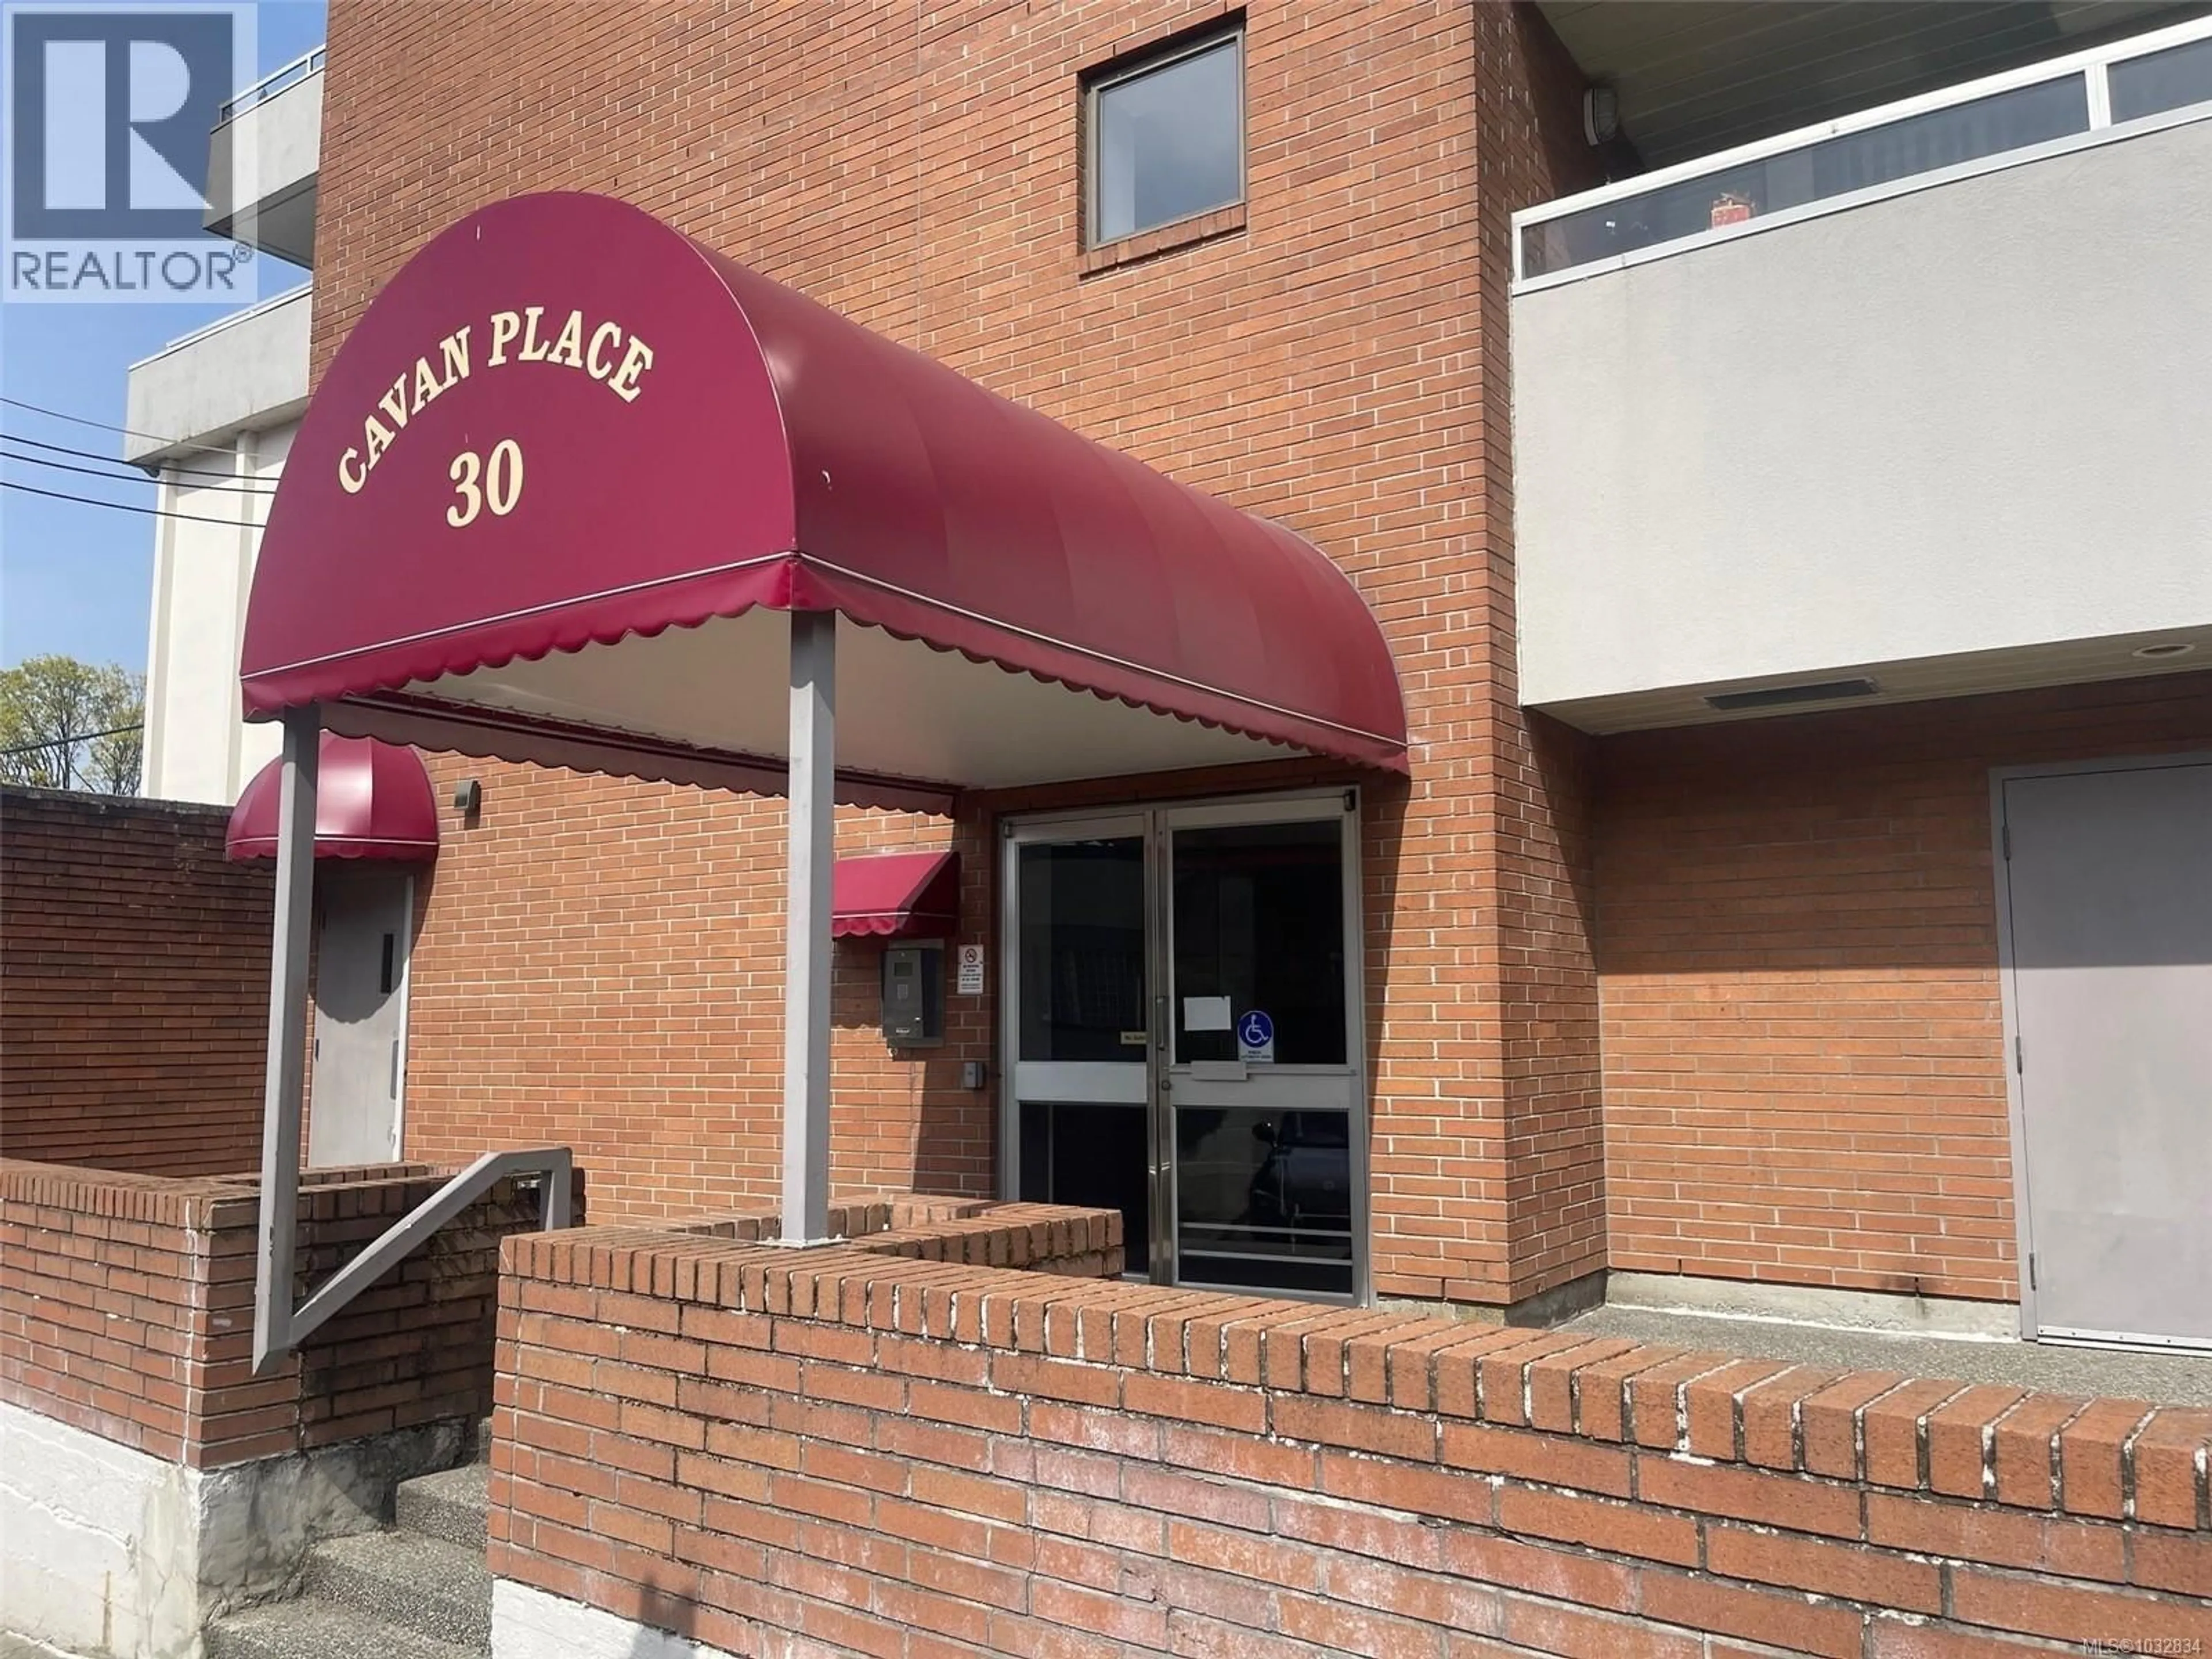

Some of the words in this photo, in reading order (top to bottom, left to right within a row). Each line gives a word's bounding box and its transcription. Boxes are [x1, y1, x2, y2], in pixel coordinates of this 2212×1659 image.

[339, 325, 471, 494] CAVAN
[487, 306, 654, 403] PLACE
[446, 438, 524, 528] 30
